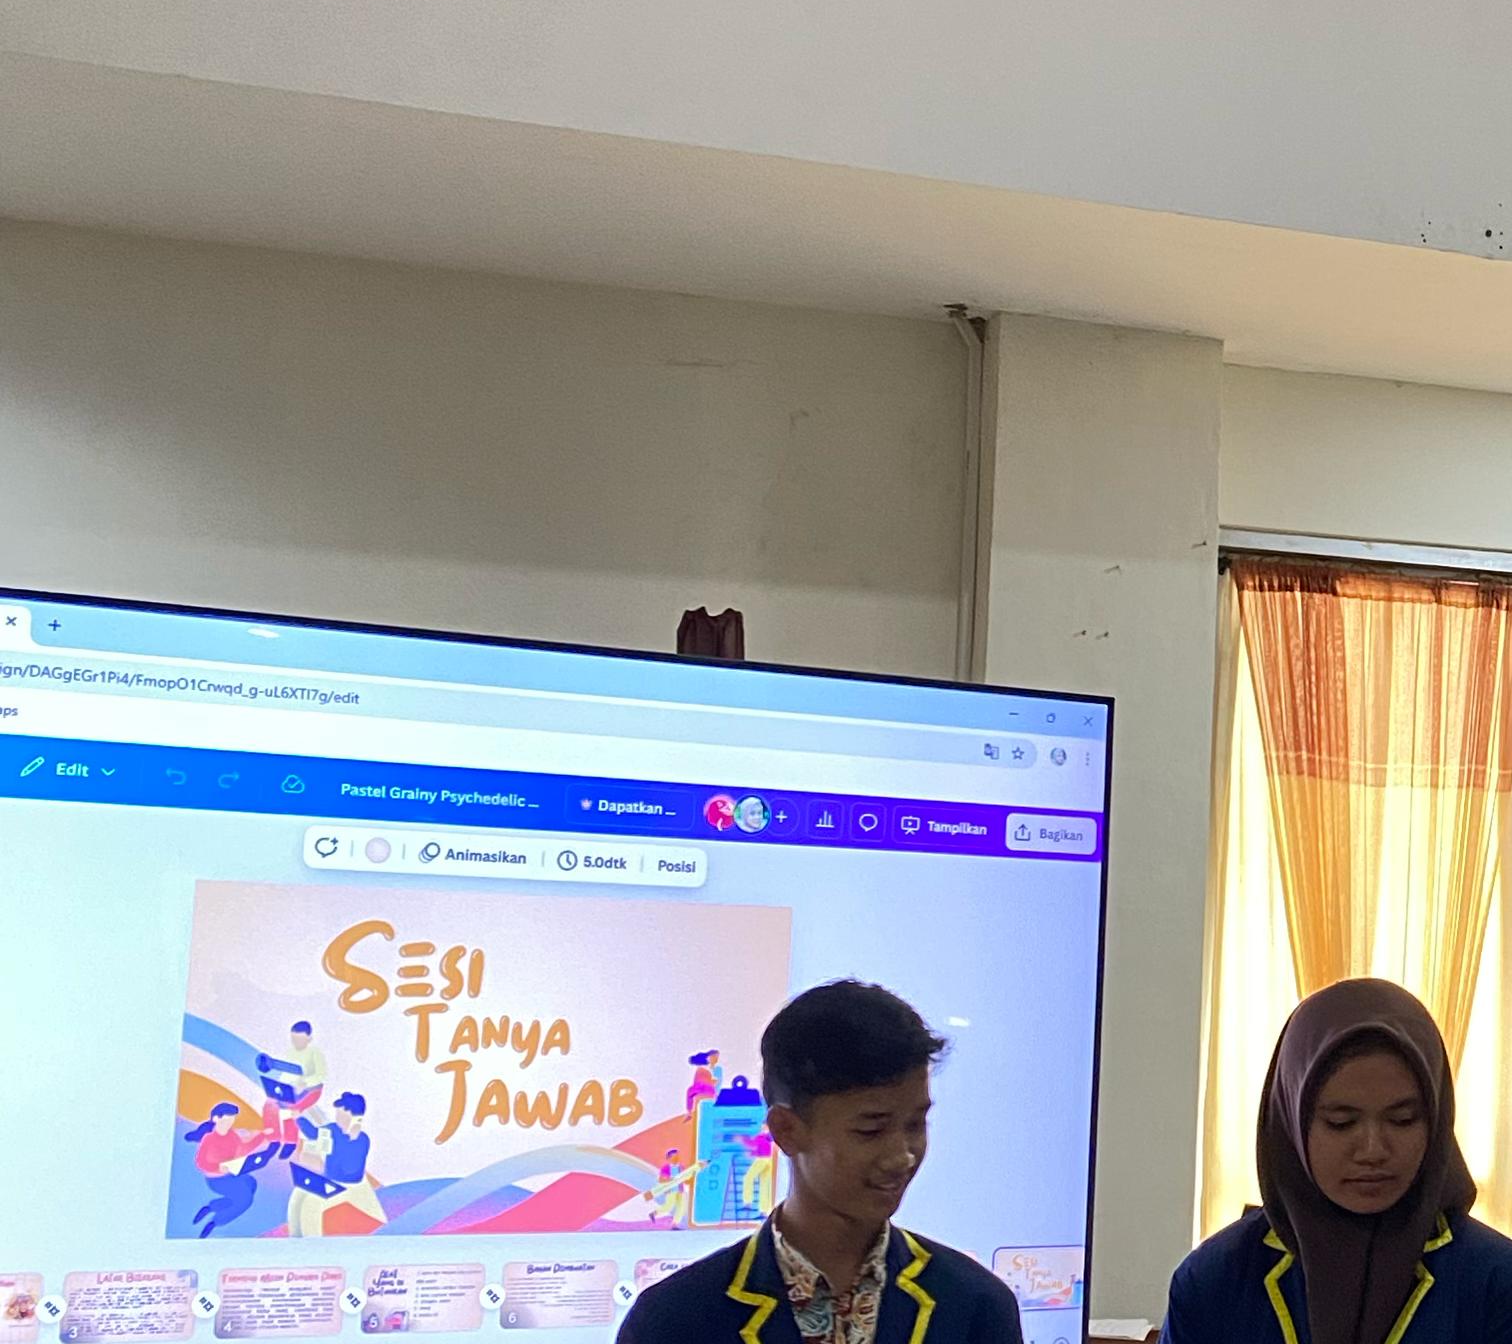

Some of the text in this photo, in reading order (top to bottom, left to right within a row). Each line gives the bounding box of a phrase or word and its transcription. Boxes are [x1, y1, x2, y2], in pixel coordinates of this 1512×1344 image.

[56, 762, 89, 777] Edit
[340, 783, 526, 809] Pastel Grainy Psychedelic
[598, 799, 663, 819] Dapatkan
[927, 820, 988, 838] Tampilkan
[1039, 827, 1084, 844] Bagikan
[444, 848, 527, 865] Animasikan
[658, 860, 696, 874] Posisi
[322, 919, 485, 1014] SESI
[404, 1003, 571, 1069] TANYA
[434, 1059, 643, 1145] JAWAB
[508, 1313, 517, 1323] 6
